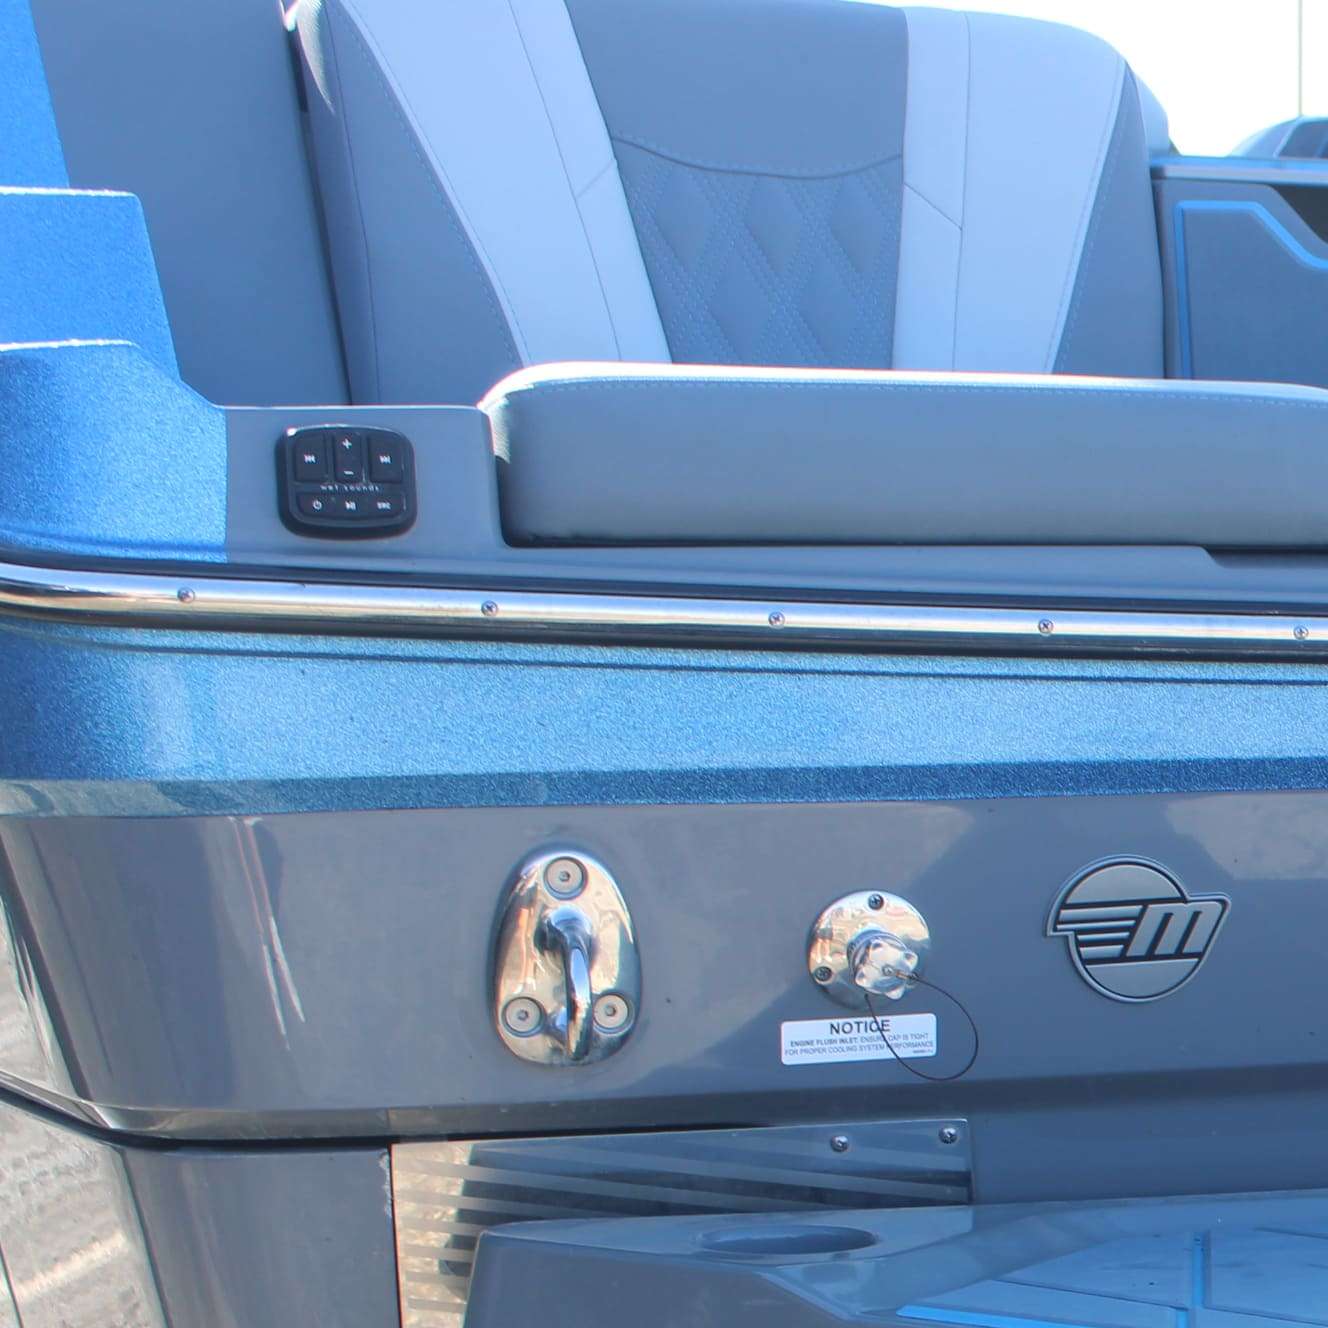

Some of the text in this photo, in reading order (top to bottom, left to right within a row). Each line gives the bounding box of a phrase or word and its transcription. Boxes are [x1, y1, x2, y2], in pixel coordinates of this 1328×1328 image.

[829, 1019, 891, 1035] NOTICE
[790, 1039, 814, 1047] ENGINE
[828, 1045, 858, 1054] COOLING
[859, 1043, 885, 1051] SYSTEM
